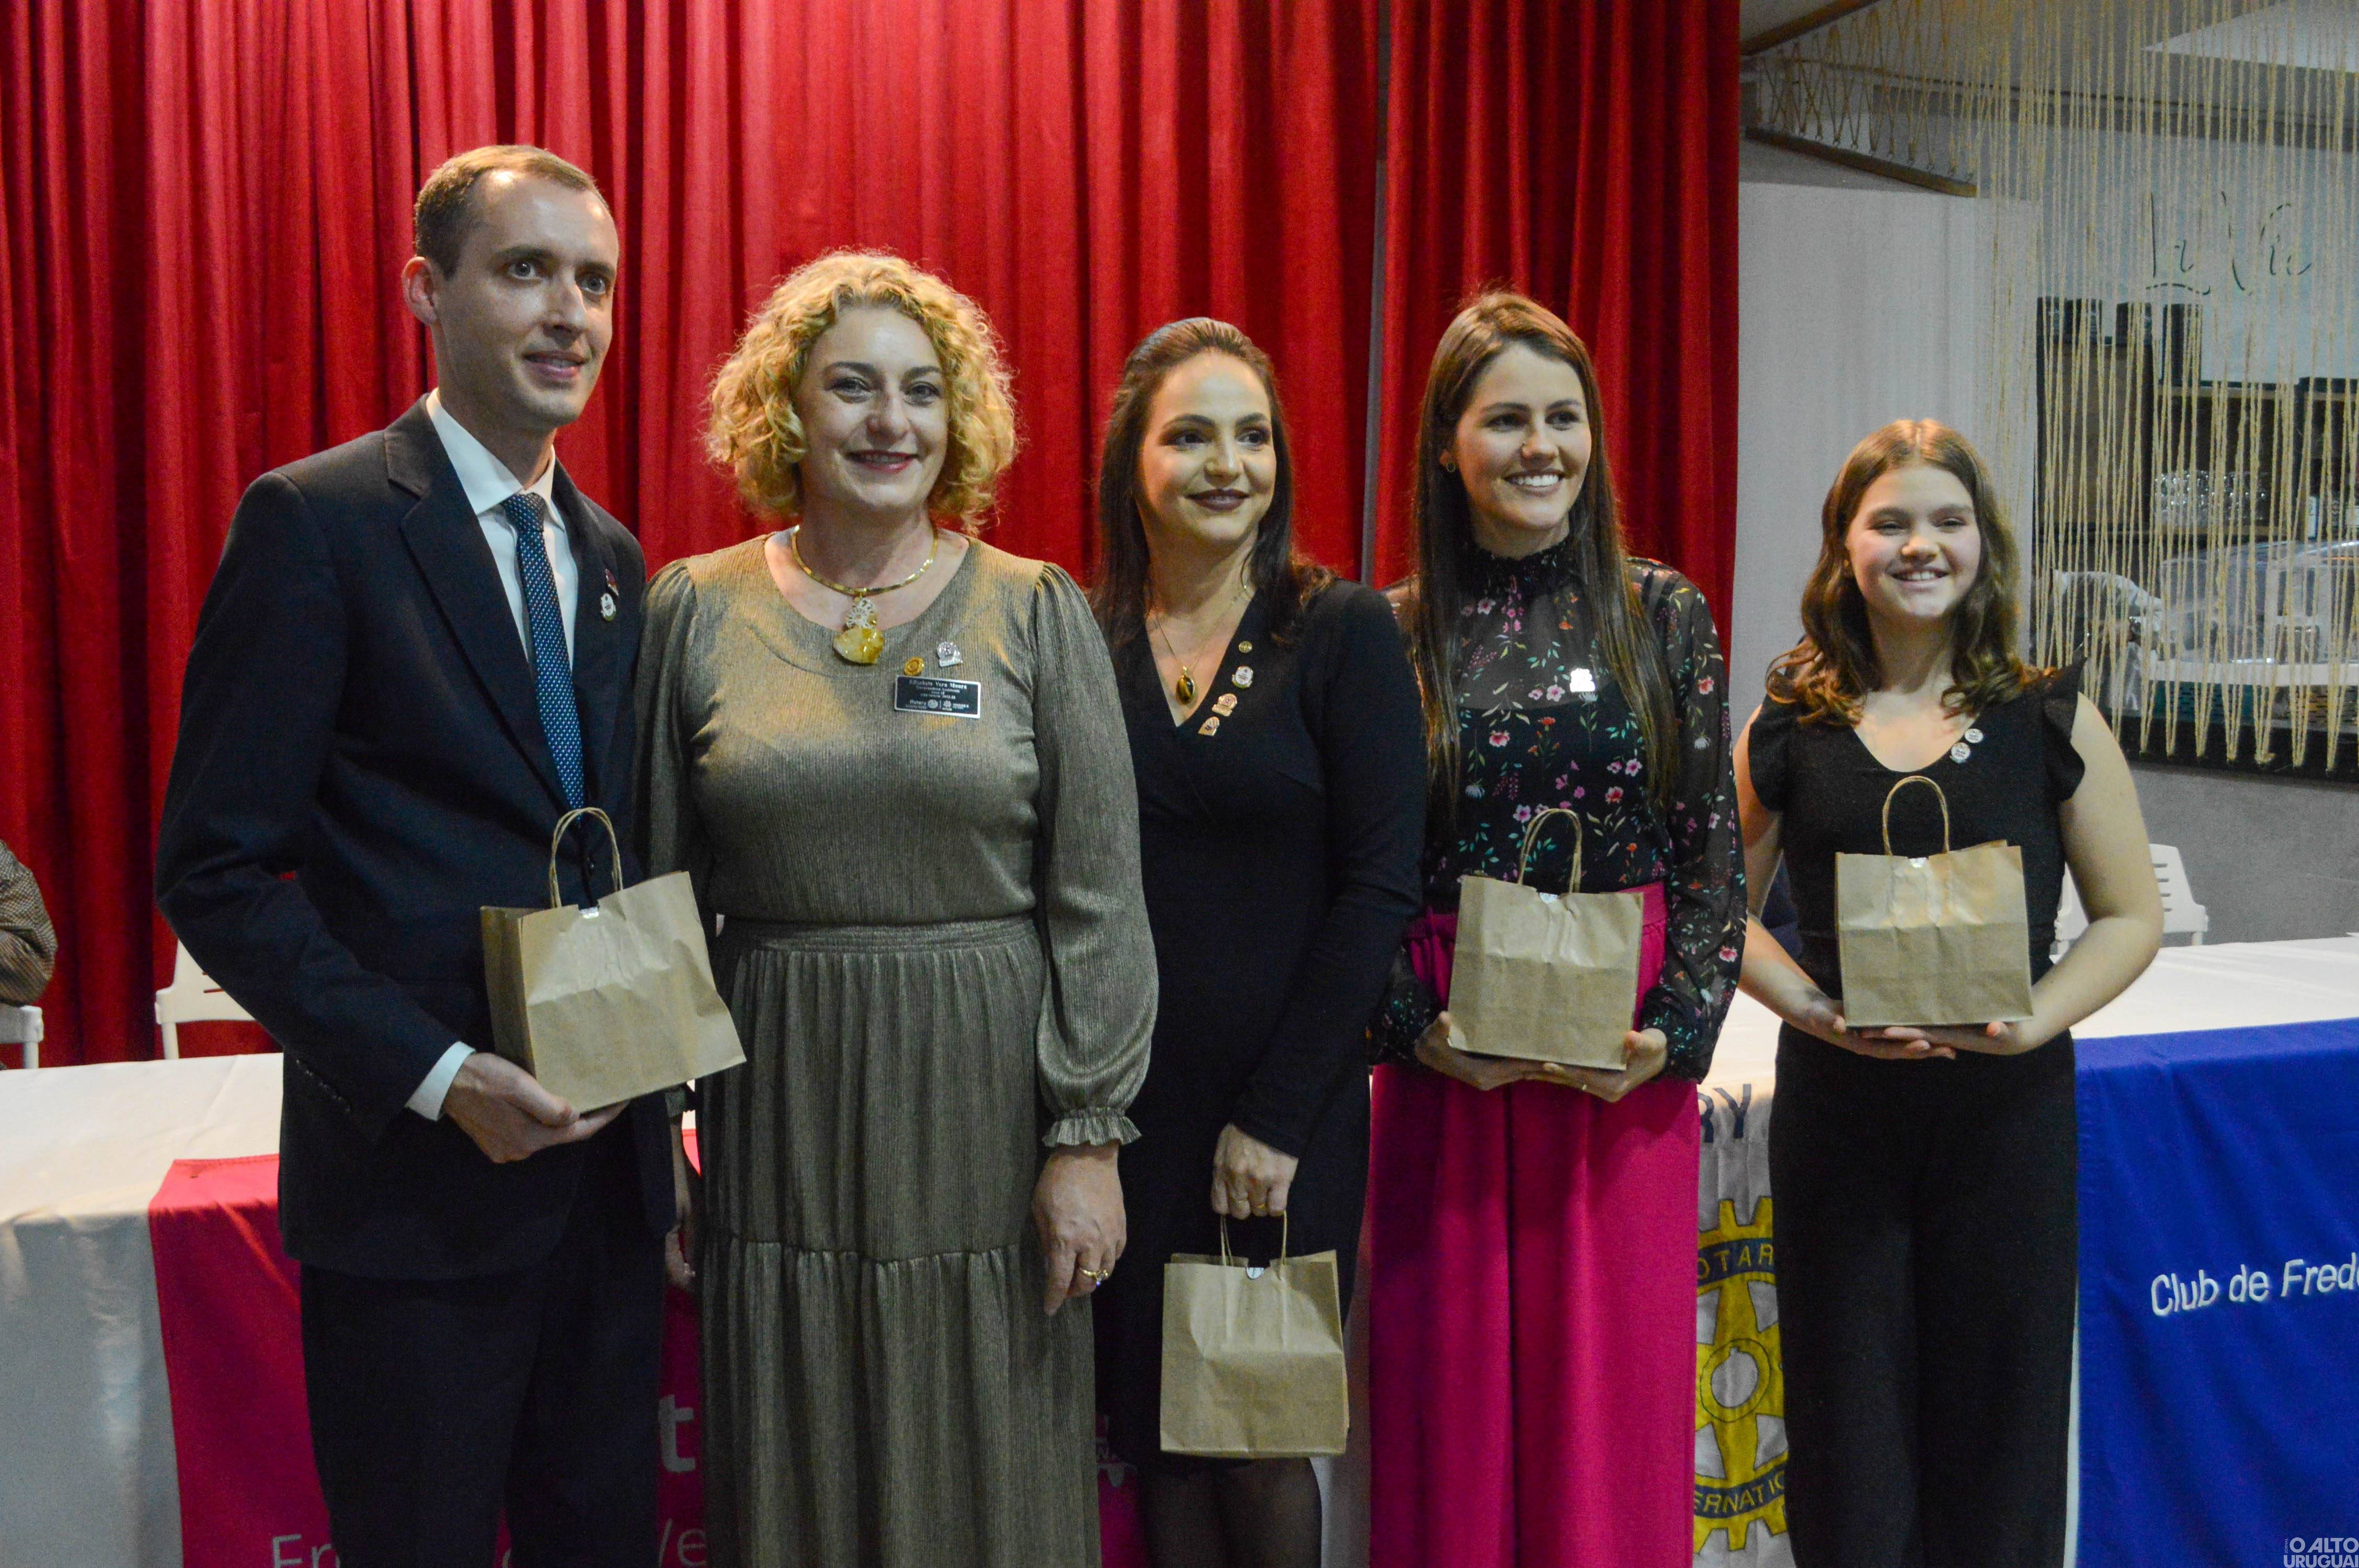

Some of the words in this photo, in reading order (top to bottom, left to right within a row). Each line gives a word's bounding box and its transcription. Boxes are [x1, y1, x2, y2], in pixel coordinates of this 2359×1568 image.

[2150, 1269, 2220, 1317] Club
[2228, 1264, 2270, 1303] de
[2281, 1252, 2359, 1297] Fred
